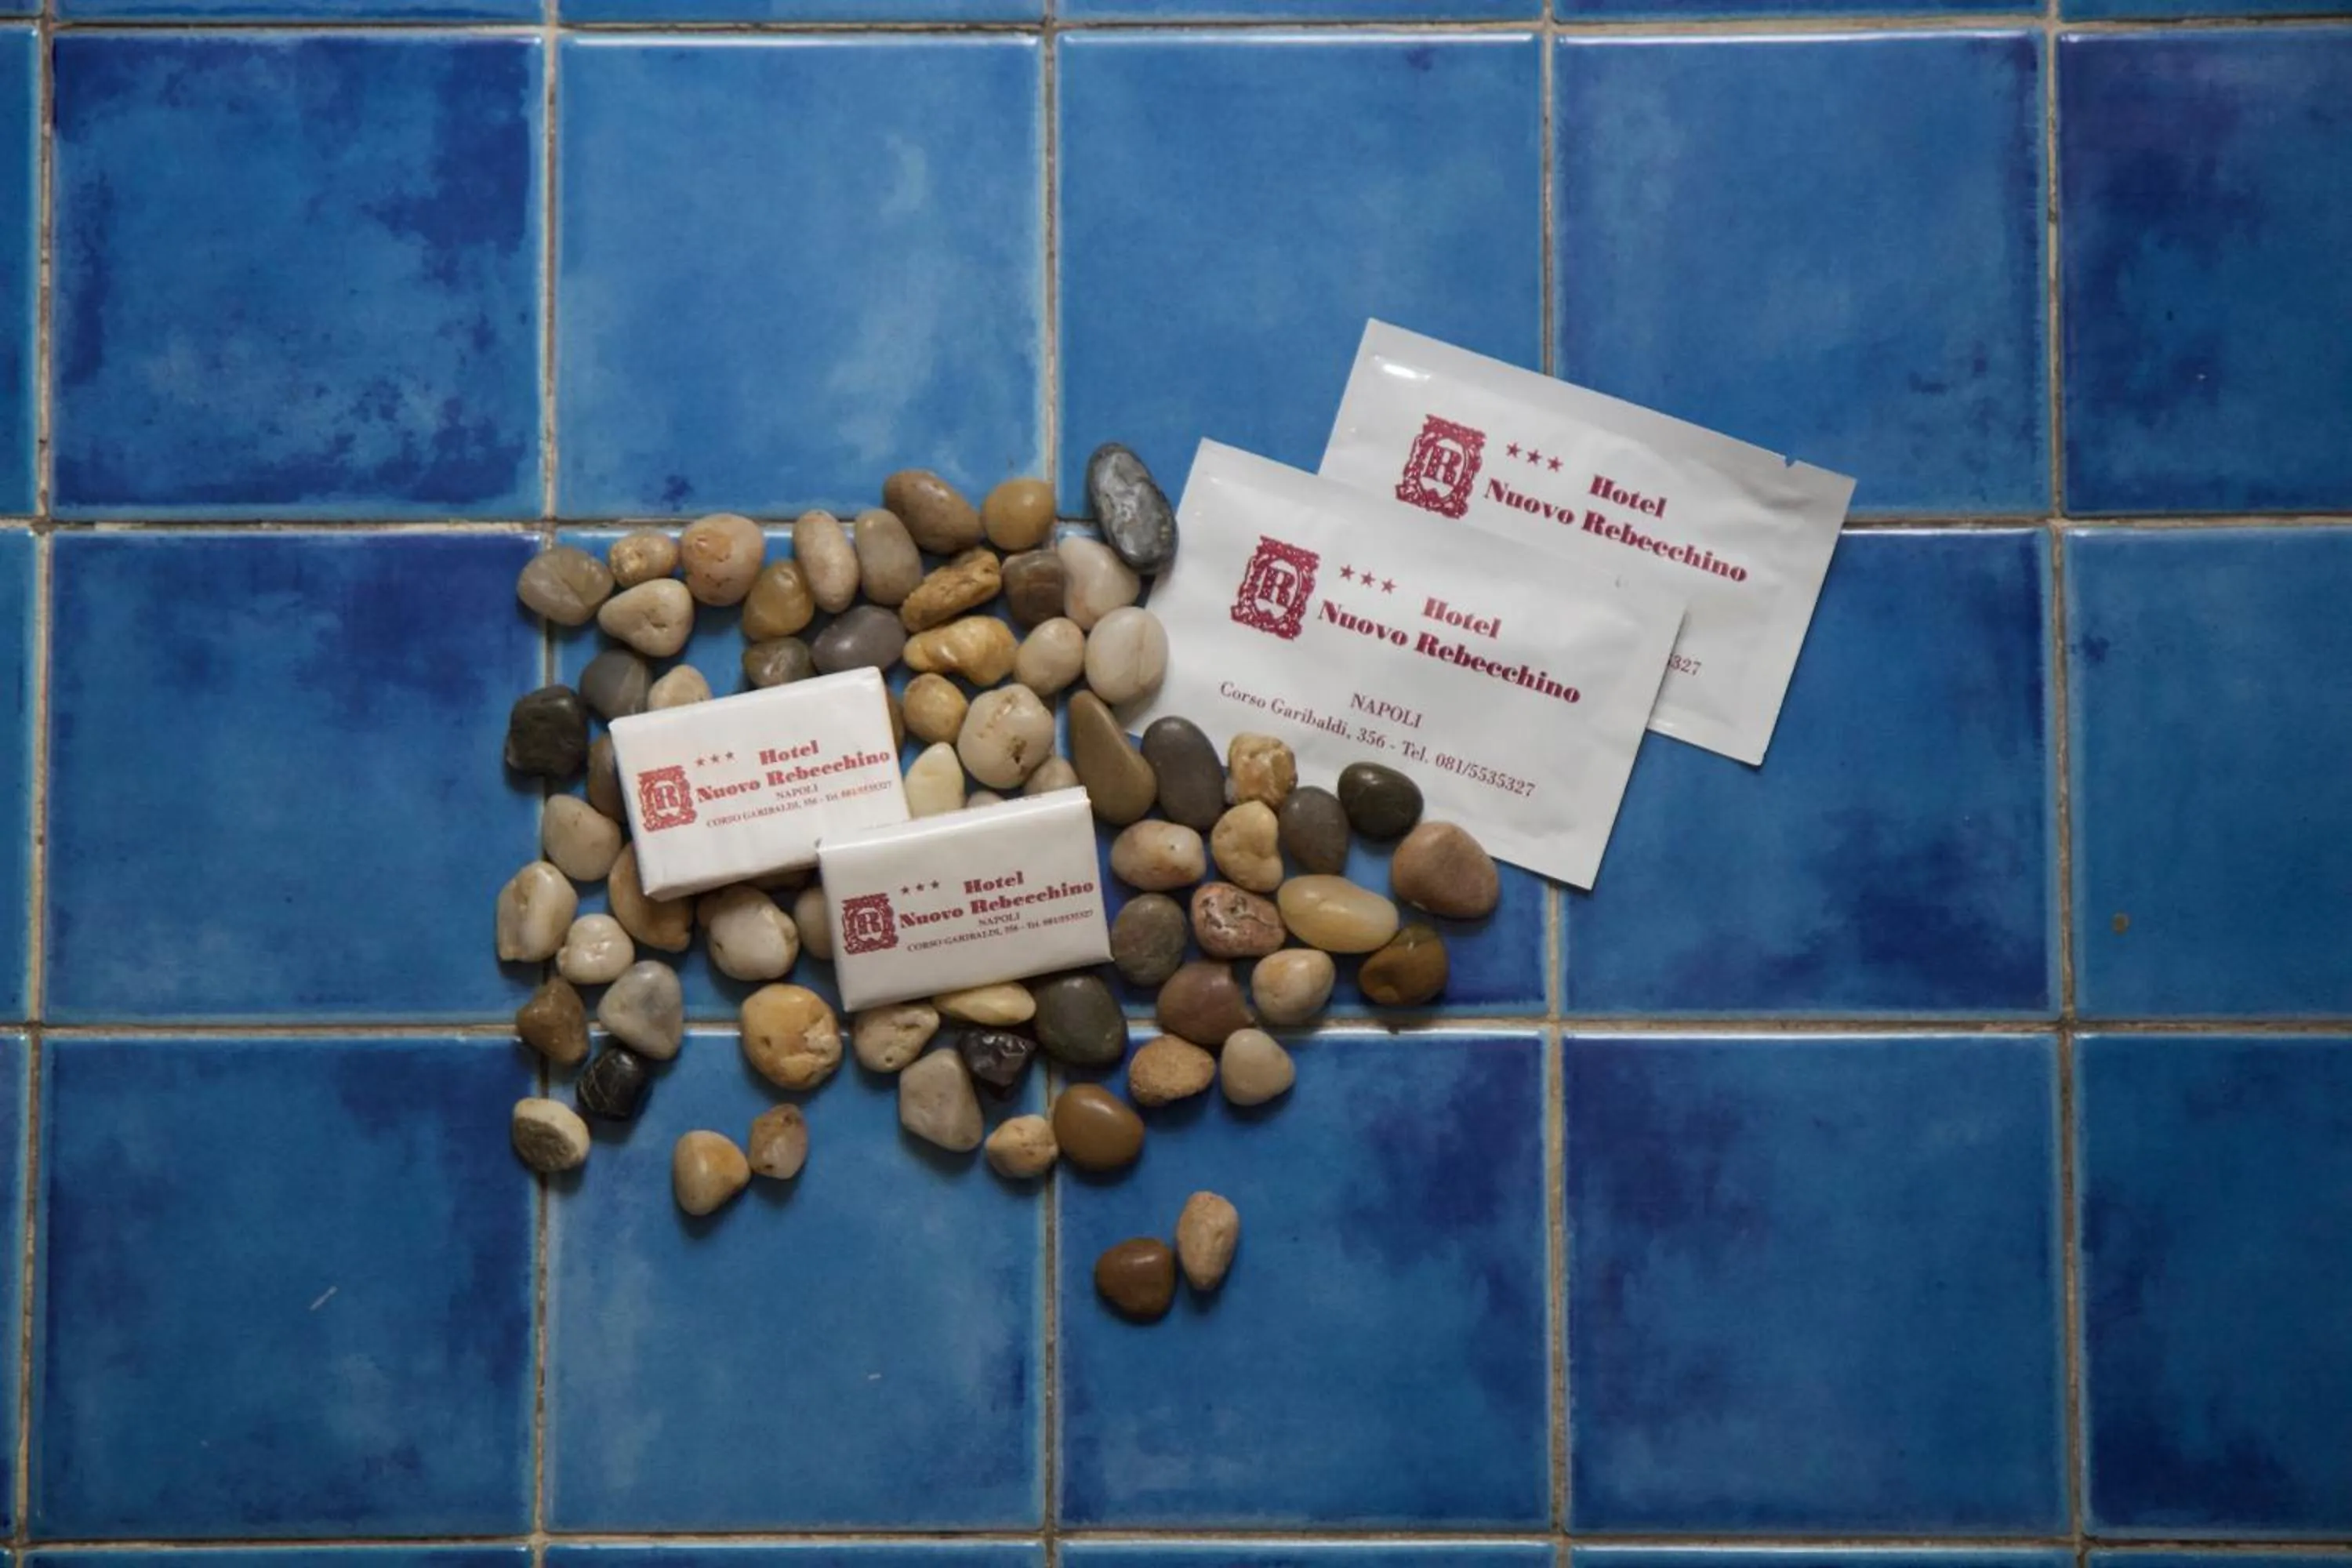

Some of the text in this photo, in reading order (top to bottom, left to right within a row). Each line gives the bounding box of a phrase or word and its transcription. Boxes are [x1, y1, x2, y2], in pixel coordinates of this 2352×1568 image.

[1422, 445, 1462, 484] R
[1588, 474, 1667, 519] Hotel
[1484, 478, 1748, 583] Nuovo Rebecchino
[1258, 567, 1295, 608] R
[1421, 597, 1501, 639] Hotel
[1318, 600, 1581, 703] Nuovo Rebecchino
[1350, 693, 1422, 728] NAPOLI
[759, 740, 819, 766] Hotel
[1220, 681, 1266, 709] Corso
[1271, 698, 1351, 739] Garibaldi,
[1356, 728, 1388, 749] 356
[1402, 740, 1428, 764] Tel.
[1436, 753, 1537, 797] 081/5535327
[698, 750, 891, 803] Nuovo Rebecchino
[776, 784, 818, 800] NAPOLI
[963, 870, 1024, 895] Hotel
[899, 880, 1094, 928] Nuovo Rebecchino
[978, 912, 1020, 926] NAPOLI
